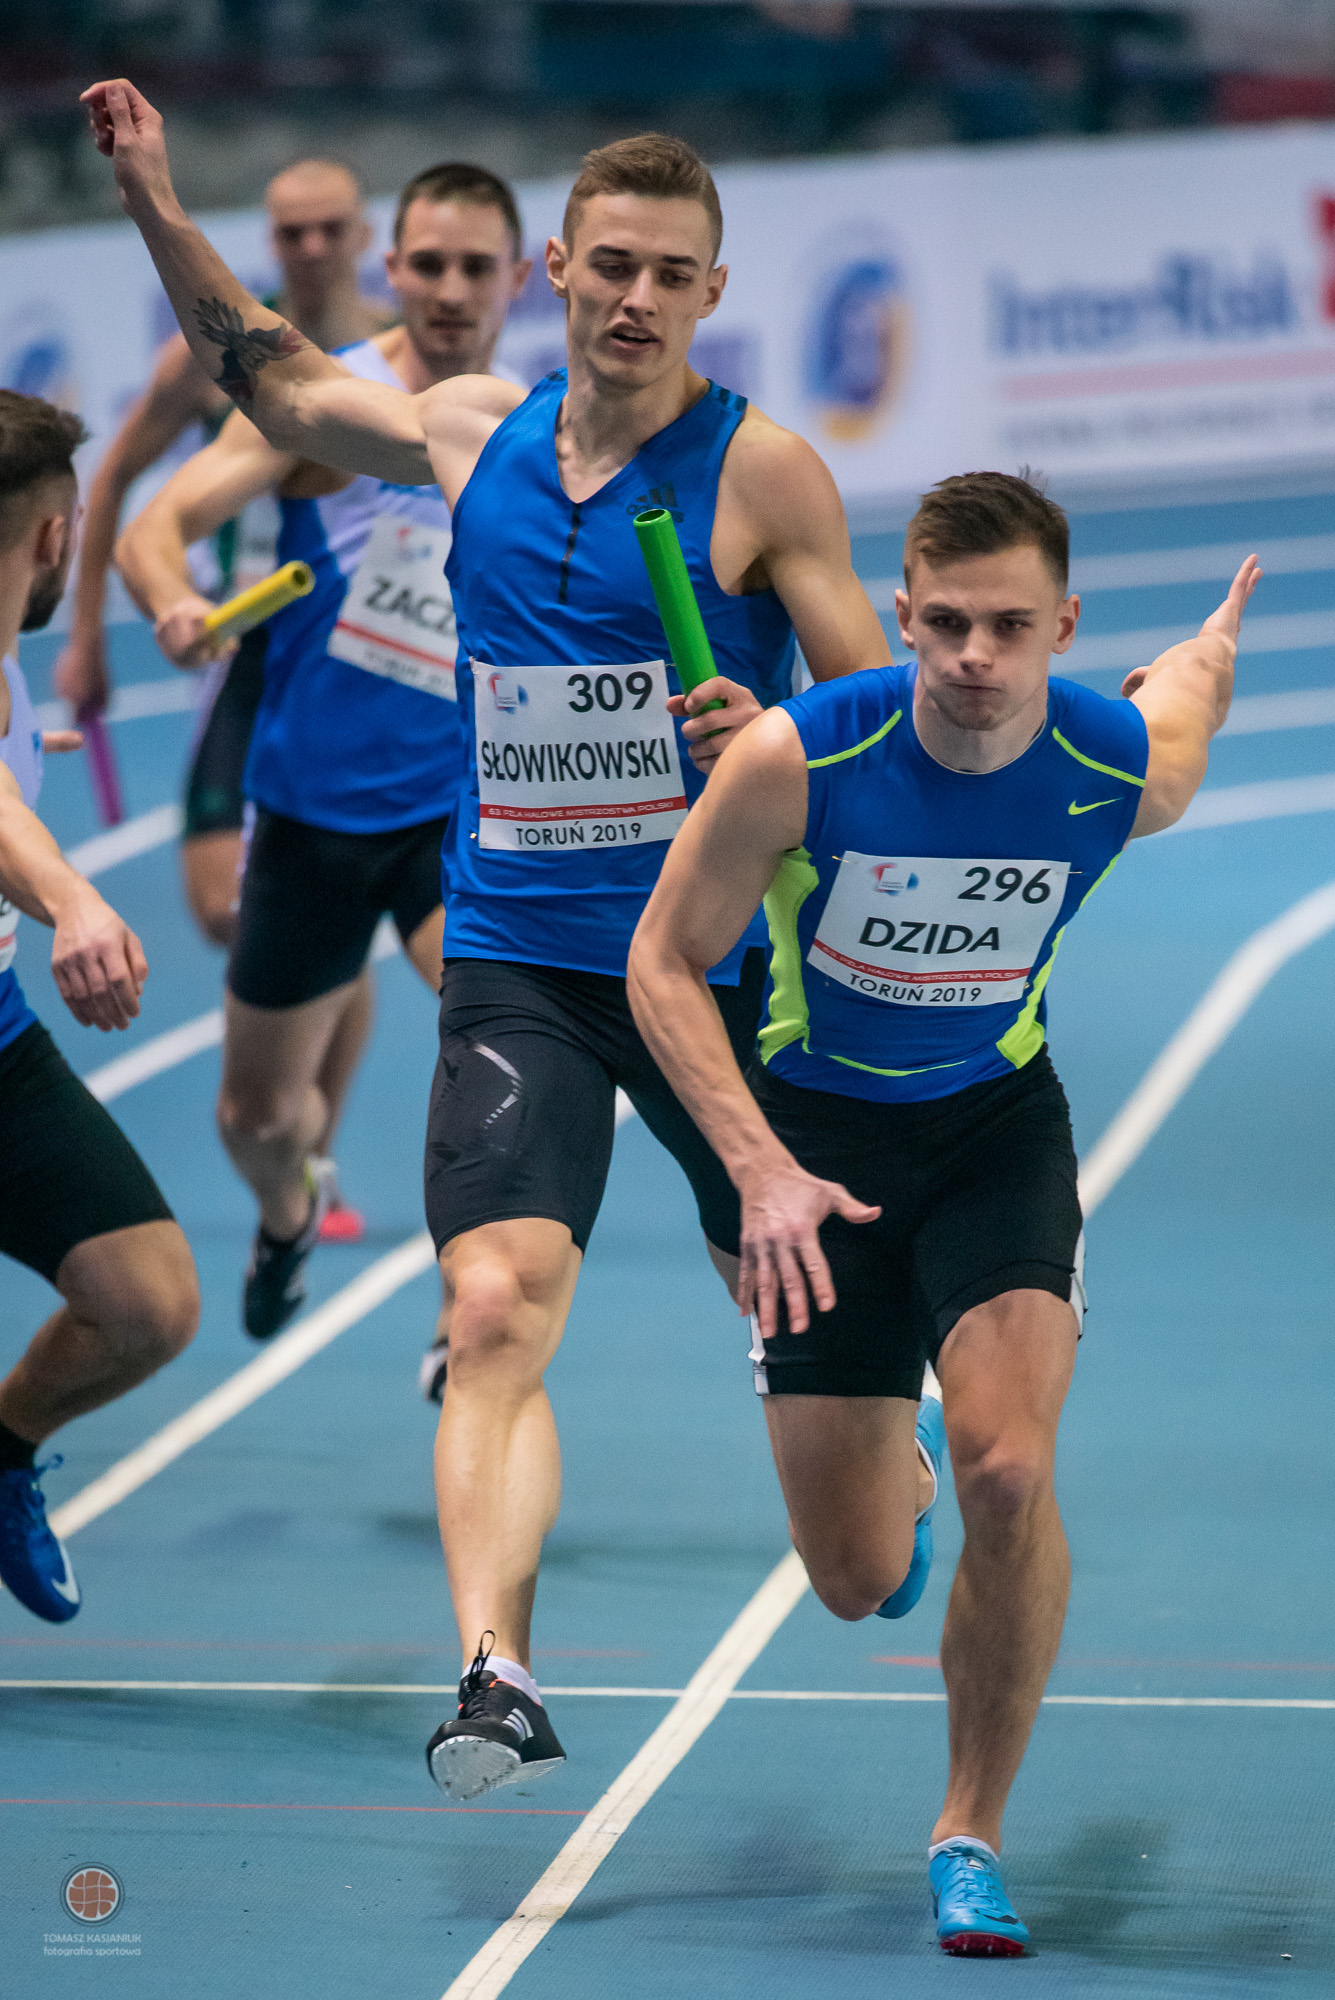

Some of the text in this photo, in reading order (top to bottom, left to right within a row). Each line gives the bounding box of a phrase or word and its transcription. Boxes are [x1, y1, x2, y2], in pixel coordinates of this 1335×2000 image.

[567, 671, 653, 713] 309
[481, 737, 671, 783] SŁOWIKOWSKI
[566, 807, 636, 817] MISTRZOSTWA
[638, 801, 674, 812] POLSKI
[516, 821, 642, 845] TORUŃ 2019
[957, 866, 1052, 904] 296
[858, 916, 1000, 955] DZIDA
[850, 973, 982, 1003] TORUŃ 2019
[912, 973, 983, 982] MISTRZOSTWA
[984, 972, 1019, 980] POLSKI
